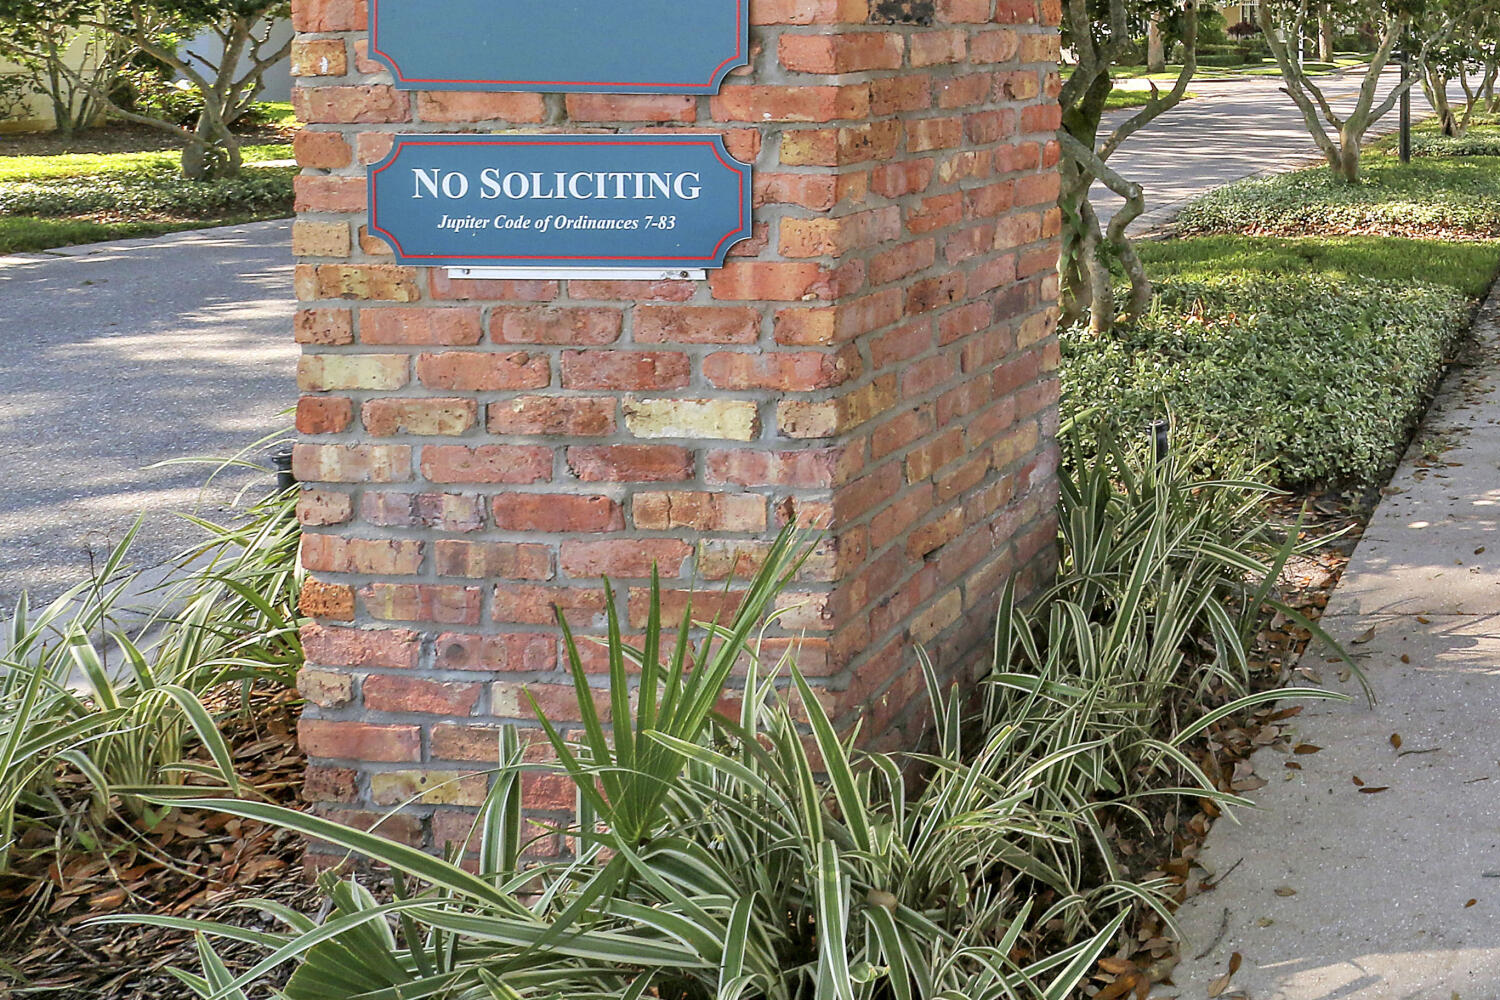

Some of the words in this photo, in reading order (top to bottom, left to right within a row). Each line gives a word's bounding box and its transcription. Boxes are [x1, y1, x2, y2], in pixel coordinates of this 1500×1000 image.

[411, 167, 469, 199] NO
[480, 167, 702, 200] SOLICITING
[437, 214, 490, 233] Jupiter
[494, 214, 532, 230] Code
[534, 214, 553, 233] of
[554, 214, 639, 231] Ordinances
[644, 214, 676, 231] 7-83
